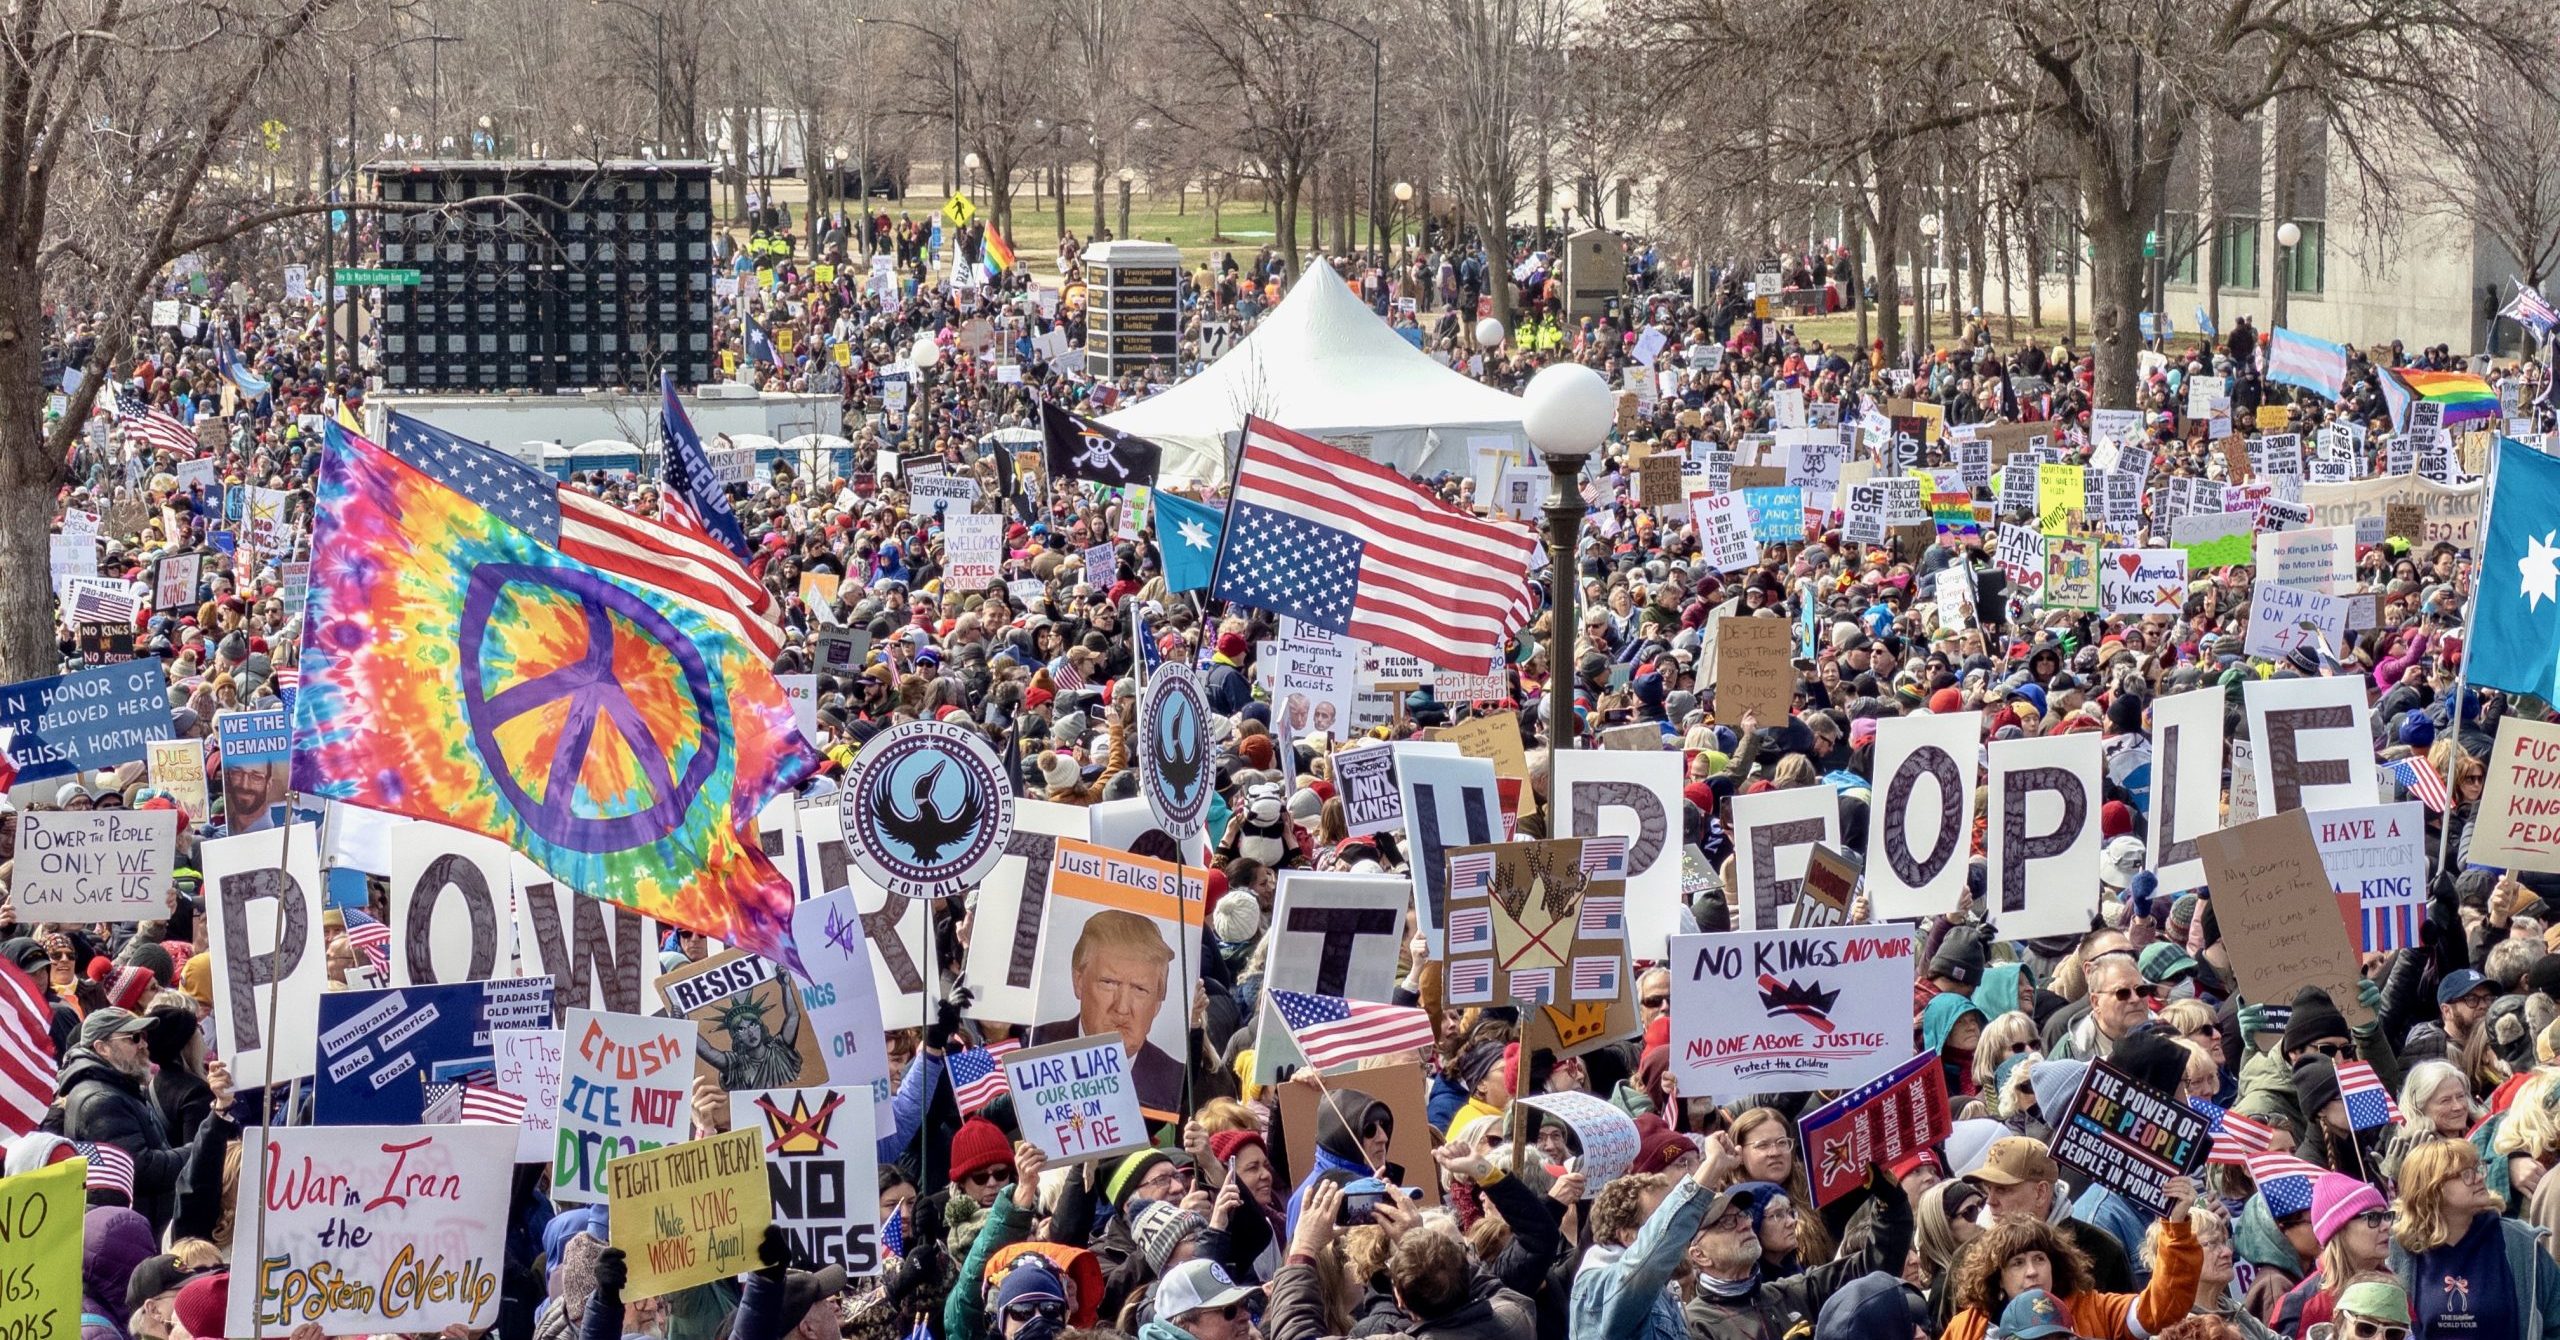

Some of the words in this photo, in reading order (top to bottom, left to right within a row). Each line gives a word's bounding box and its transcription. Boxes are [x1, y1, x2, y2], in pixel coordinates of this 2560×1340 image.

[1124, 269, 1172, 277] Transportation
[1124, 278, 1152, 286] Building
[1123, 295, 1148, 304] Judicial
[1123, 322, 1152, 331] Building
[1123, 344, 1152, 353] Building
[2332, 425, 2349, 436] NO
[2266, 436, 2296, 449] $200B
[709, 452, 734, 468] MASK
[736, 449, 754, 463] OFF
[2332, 449, 2352, 460] NO
[1644, 470, 1678, 481] PEOPLE
[2315, 463, 2346, 476] $200B
[913, 486, 971, 500] EVERYWHERE
[1852, 487, 1884, 505] ICE
[2004, 481, 2035, 492] BILLIONS
[2108, 489, 2136, 500] BILLIONS
[1709, 496, 1730, 511] NO
[1851, 503, 1882, 516] OUT!
[955, 516, 994, 527] AMERICA
[2042, 502, 2069, 531] TWICE
[2110, 514, 2138, 522] IRAN
[2261, 503, 2308, 524] MORONS
[254, 519, 273, 532] NO
[1769, 524, 1800, 537] BETTER
[2256, 516, 2285, 531] ARE
[949, 536, 1000, 551] WELCOMES
[2274, 548, 2287, 556] No
[2287, 545, 2310, 557] Kings
[2311, 545, 2320, 553] in
[2322, 543, 2338, 552] USA
[1088, 552, 1112, 566] BOMB
[2000, 547, 2032, 567] THE
[2100, 553, 2117, 571] We
[2278, 562, 2291, 571] No
[2295, 560, 2316, 569] More
[2318, 560, 2334, 568] Lies
[166, 560, 180, 580] NO
[953, 565, 995, 577] EXPELS
[1996, 561, 2043, 590] PEDO
[2276, 574, 2331, 586] Unauthorized
[2332, 573, 2354, 582] Wars
[957, 577, 987, 590] KINGS
[81, 586, 134, 605] PRO-AMERICA
[163, 583, 187, 606] KING
[2263, 587, 2304, 611] CLEAN
[2310, 597, 2331, 612] UP
[2262, 607, 2284, 623] ON
[82, 626, 97, 636] NO
[101, 625, 129, 636] KINGS
[1724, 624, 1777, 641] DE-ICE
[1280, 638, 1343, 663] Immigrants
[1291, 659, 1334, 677] DEPORT
[1385, 657, 1419, 667] FELONS
[1159, 664, 1196, 686] JUSTICE
[1380, 668, 1399, 678] SELL
[1401, 668, 1423, 678] OUTS
[1434, 674, 1466, 688] don't
[1471, 673, 1504, 690] forget
[1284, 674, 1334, 692] Racists
[1727, 684, 1742, 696] NO
[1745, 685, 1777, 699] KINGS
[1434, 686, 1504, 701] trumpstein
[224, 717, 249, 734] WE
[252, 715, 286, 731] THE
[890, 723, 972, 745] JUSTICE
[225, 736, 288, 757] DEMAND
[155, 748, 192, 766] DUE
[1346, 761, 1388, 776] DEMOCRACY
[843, 760, 867, 858] FREEDOM
[991, 764, 1012, 851] LIBERTY
[1348, 794, 1401, 824] KINGS
[2508, 794, 2560, 817] KING
[1163, 818, 1181, 836] FOR
[1184, 818, 1201, 838] ALL
[2322, 819, 2376, 844] HAVE
[2386, 818, 2402, 838] A
[41, 851, 104, 875] ONLY
[117, 849, 156, 874] WE
[1058, 851, 1100, 877] Just
[1106, 863, 1158, 892] Talks
[887, 876, 924, 897] FOR
[933, 876, 969, 898] ALL
[1693, 946, 1743, 981] NO
[1842, 939, 1874, 964] NO
[486, 976, 552, 991] MINNESOTA
[673, 954, 768, 1011] RESIST
[495, 990, 541, 1004] BADASS
[486, 1005, 513, 1017] OLD
[515, 1003, 549, 1016] WHITE
[326, 1001, 400, 1053] Immigrants
[382, 1006, 436, 1046] America
[493, 1019, 536, 1030] WOMAN
[477, 1031, 490, 1042] IN
[833, 1030, 857, 1058] OR
[1685, 1040, 1715, 1061] NO
[1716, 1034, 1750, 1055] ONE
[1753, 1033, 1805, 1051] ABOVE
[1813, 1032, 1889, 1049] JUSTICE.
[334, 1051, 371, 1080] Make
[374, 1056, 413, 1087] Great
[1015, 1057, 1066, 1092] LIAR
[1073, 1045, 1121, 1082] LIAR
[1734, 1059, 1772, 1076] Protect
[1775, 1057, 1791, 1070] the
[1795, 1057, 1829, 1070] Children
[1035, 1083, 1068, 1106] OUR
[1073, 1075, 1120, 1102] RIGHTS
[562, 1074, 621, 1127] ICE
[631, 1086, 683, 1127] NOT
[2090, 1068, 2124, 1101] THE
[2121, 1085, 2177, 1133] POWER
[2177, 1115, 2203, 1142] OF
[1044, 1103, 1074, 1124] ARE
[1084, 1099, 1103, 1118] ON
[1909, 1075, 1930, 1146] HEALTHCARE
[1055, 1114, 1122, 1156] FIRE
[1882, 1093, 1902, 1161] HEALTHCARE
[2081, 1089, 2116, 1127] THE
[2117, 1109, 2192, 1166] PEOPLE
[2066, 1124, 2080, 1140] IS
[2078, 1130, 2125, 1166] GREATER
[2125, 1153, 2155, 1183] THAN
[2155, 1171, 2171, 1188] TH
[266, 1140, 347, 1212] War
[344, 1186, 361, 1207] in
[363, 1136, 461, 1213] Iran
[615, 1159, 660, 1200] FIGHT
[665, 1143, 709, 1186] TRUTH
[712, 1133, 759, 1180] DECAY!
[2058, 1139, 2108, 1177] PEOPLE
[2105, 1163, 2122, 1185] IN
[2122, 1173, 2169, 1210] POWER
[766, 1160, 846, 1220] NO
[654, 1203, 686, 1239] Make
[690, 1187, 738, 1235] LYING
[317, 1217, 373, 1249] the
[648, 1232, 696, 1277] WRONG
[707, 1225, 745, 1274] Again!
[2438, 1321, 2460, 1329] WORLD
[2460, 1321, 2478, 1329] TOUR
